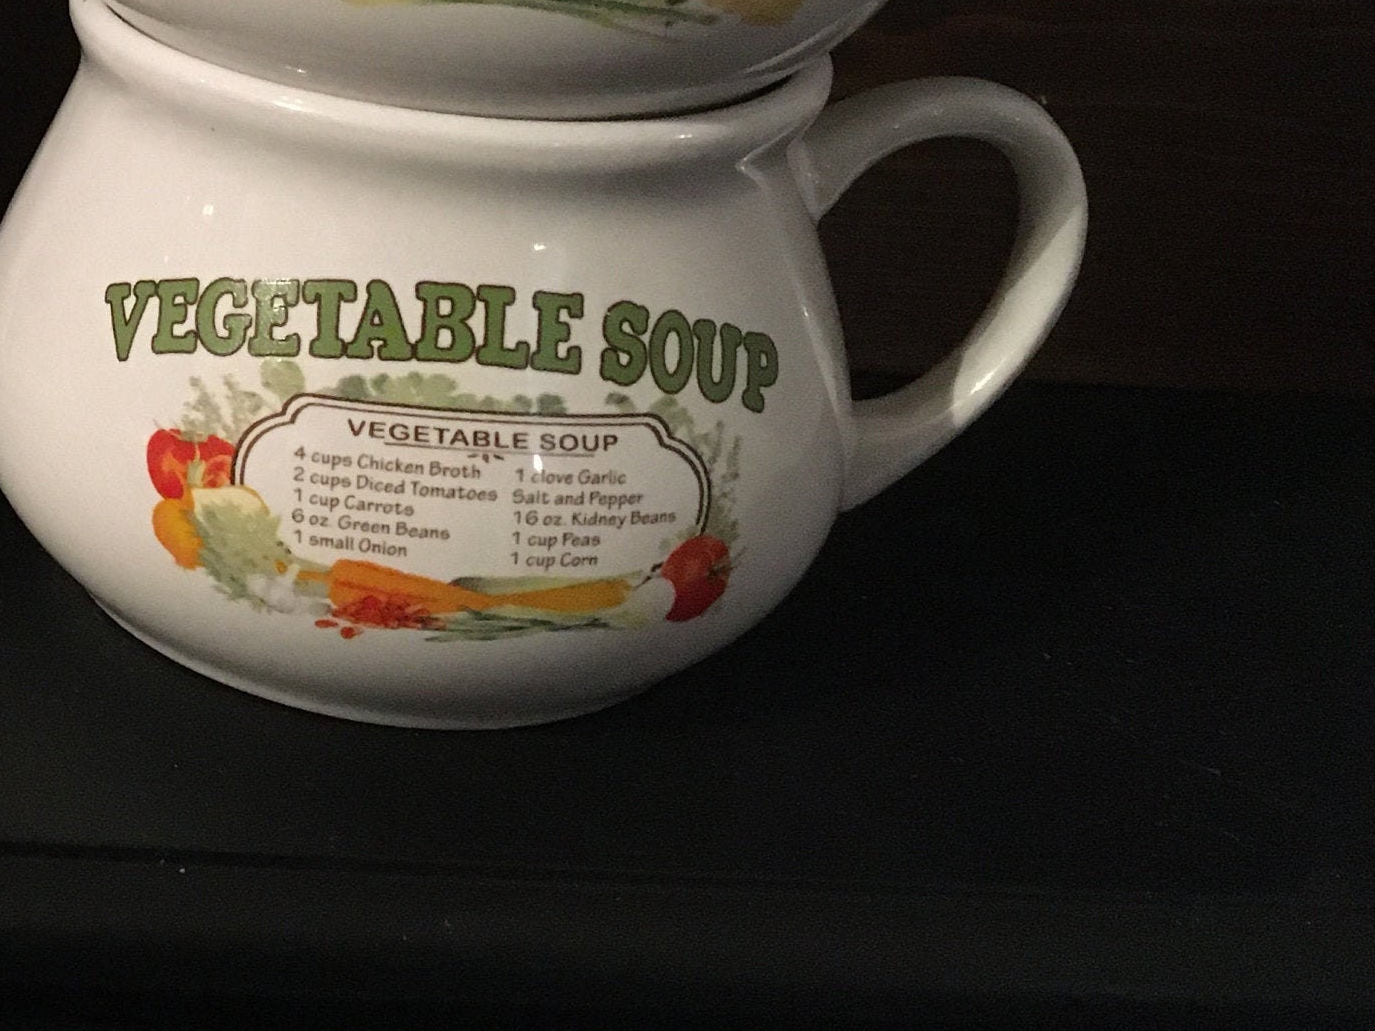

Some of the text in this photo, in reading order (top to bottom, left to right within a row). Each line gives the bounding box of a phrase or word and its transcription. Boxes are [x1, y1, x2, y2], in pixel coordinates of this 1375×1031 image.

[105, 277, 779, 414] VEGETABLE SOUP
[347, 419, 619, 452] VEGETABLE SOUP
[293, 446, 482, 479] 4 cups Chicken Broth
[292, 467, 498, 501] 2 cups Diced Tomatoes
[516, 469, 524, 483] 1
[577, 469, 626, 485] Garlic
[293, 488, 414, 516] 1 cup Carrots
[513, 489, 644, 509] Salt and Pepper
[291, 508, 305, 524] 6
[338, 516, 392, 536] Green
[395, 523, 450, 541] Beans
[513, 511, 538, 526] 16
[572, 511, 625, 528] Kidney
[628, 509, 676, 525] Beans
[294, 530, 407, 557] 1 small Onion
[512, 532, 600, 550] 1 cup Peas
[511, 552, 598, 571] 1 cup Corn
